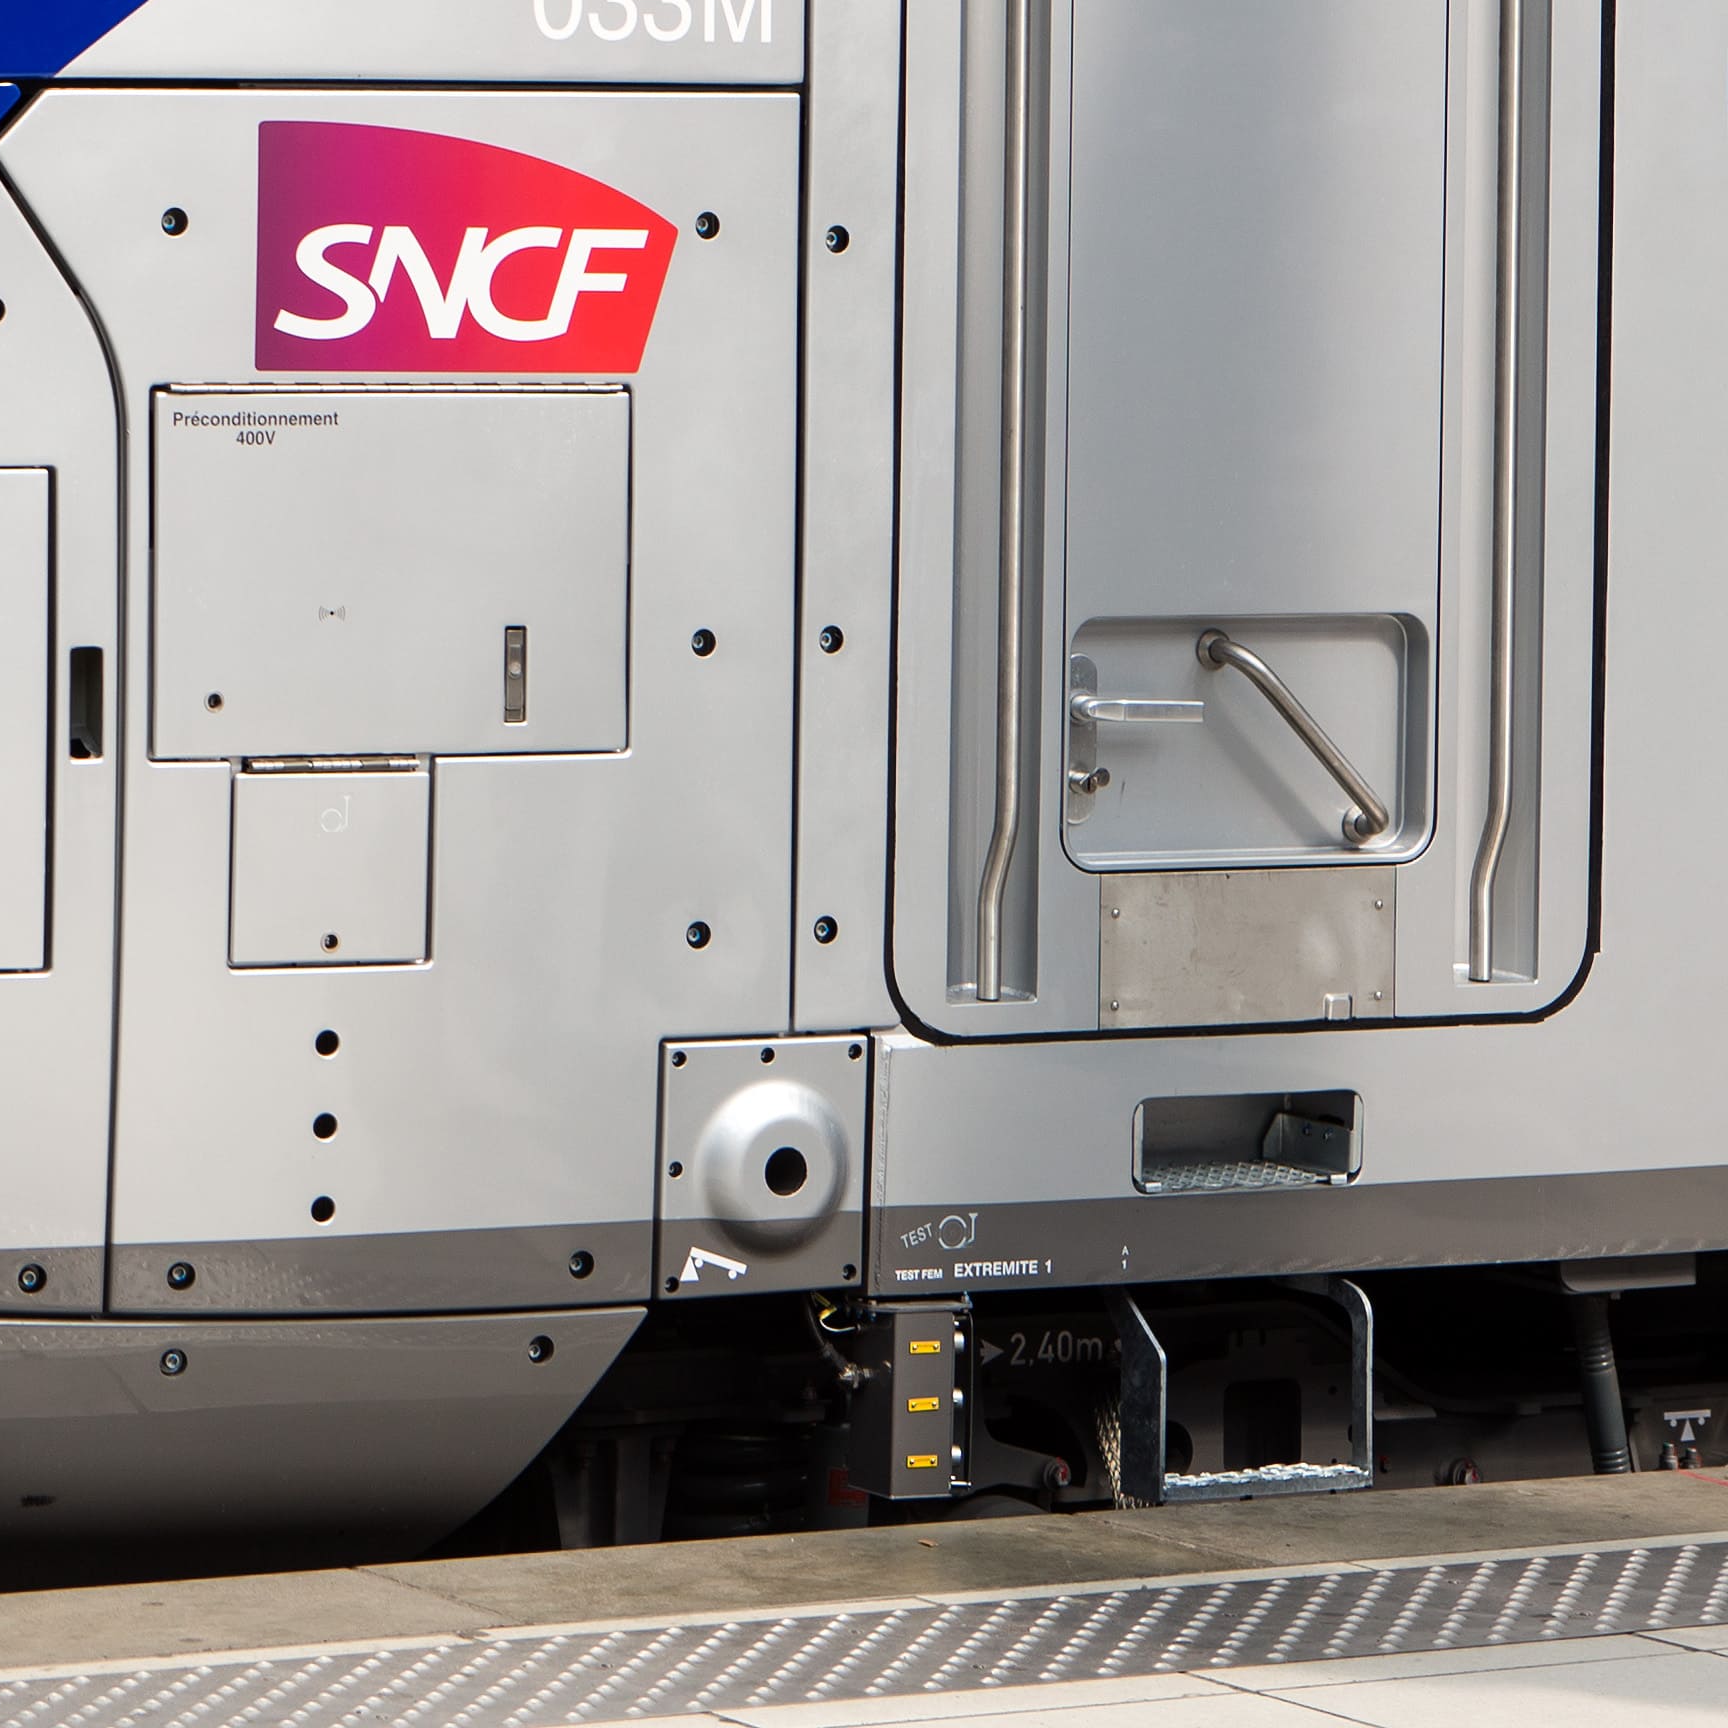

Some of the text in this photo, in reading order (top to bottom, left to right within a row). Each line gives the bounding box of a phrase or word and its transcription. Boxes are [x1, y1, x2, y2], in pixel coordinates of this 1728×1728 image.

[273, 223, 649, 342] SNCF
[172, 410, 340, 427] Préconditionnement
[235, 430, 276, 445] 400V
[900, 1222, 933, 1249] TEST
[1121, 1245, 1130, 1256] A
[895, 1258, 1053, 1281] TEST FEM EXTREMITE 1
[1121, 1259, 1127, 1270] 1
[1009, 1330, 1104, 1368] 2,40m
